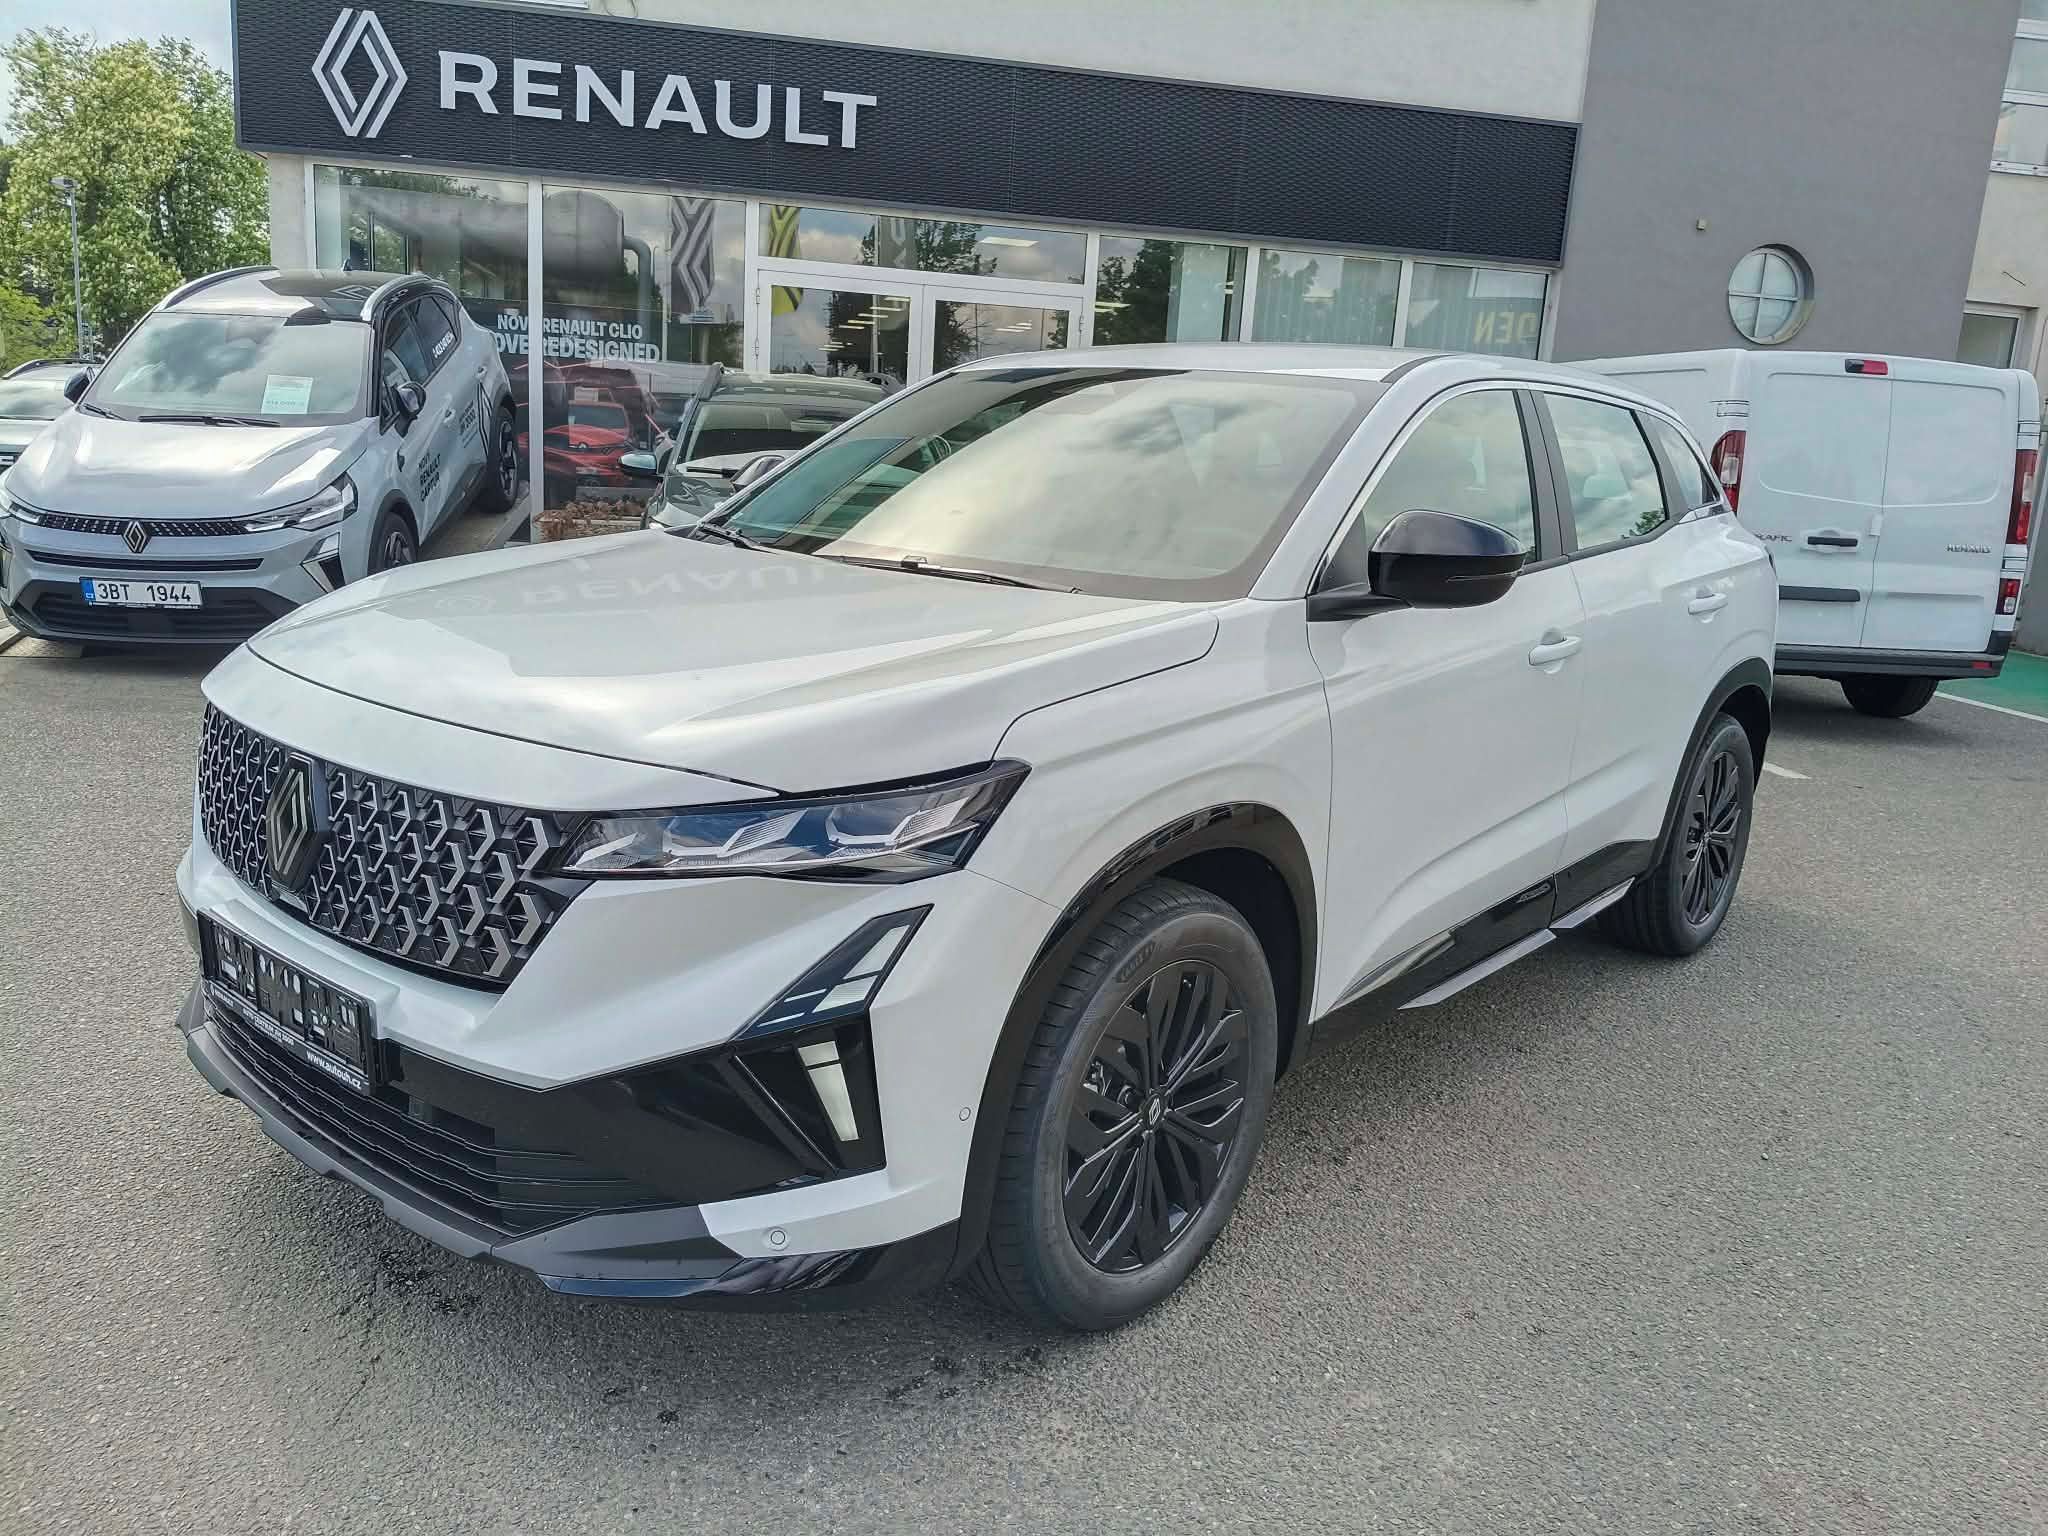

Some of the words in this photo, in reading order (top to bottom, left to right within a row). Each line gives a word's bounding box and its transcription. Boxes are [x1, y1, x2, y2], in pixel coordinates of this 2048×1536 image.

[438, 50, 877, 149] RENAULT
[497, 313, 529, 331] NOV
[543, 317, 607, 337] RENAULT
[608, 322, 643, 340] CLIO
[98, 583, 129, 601] 3BT
[146, 585, 191, 602] 1944
